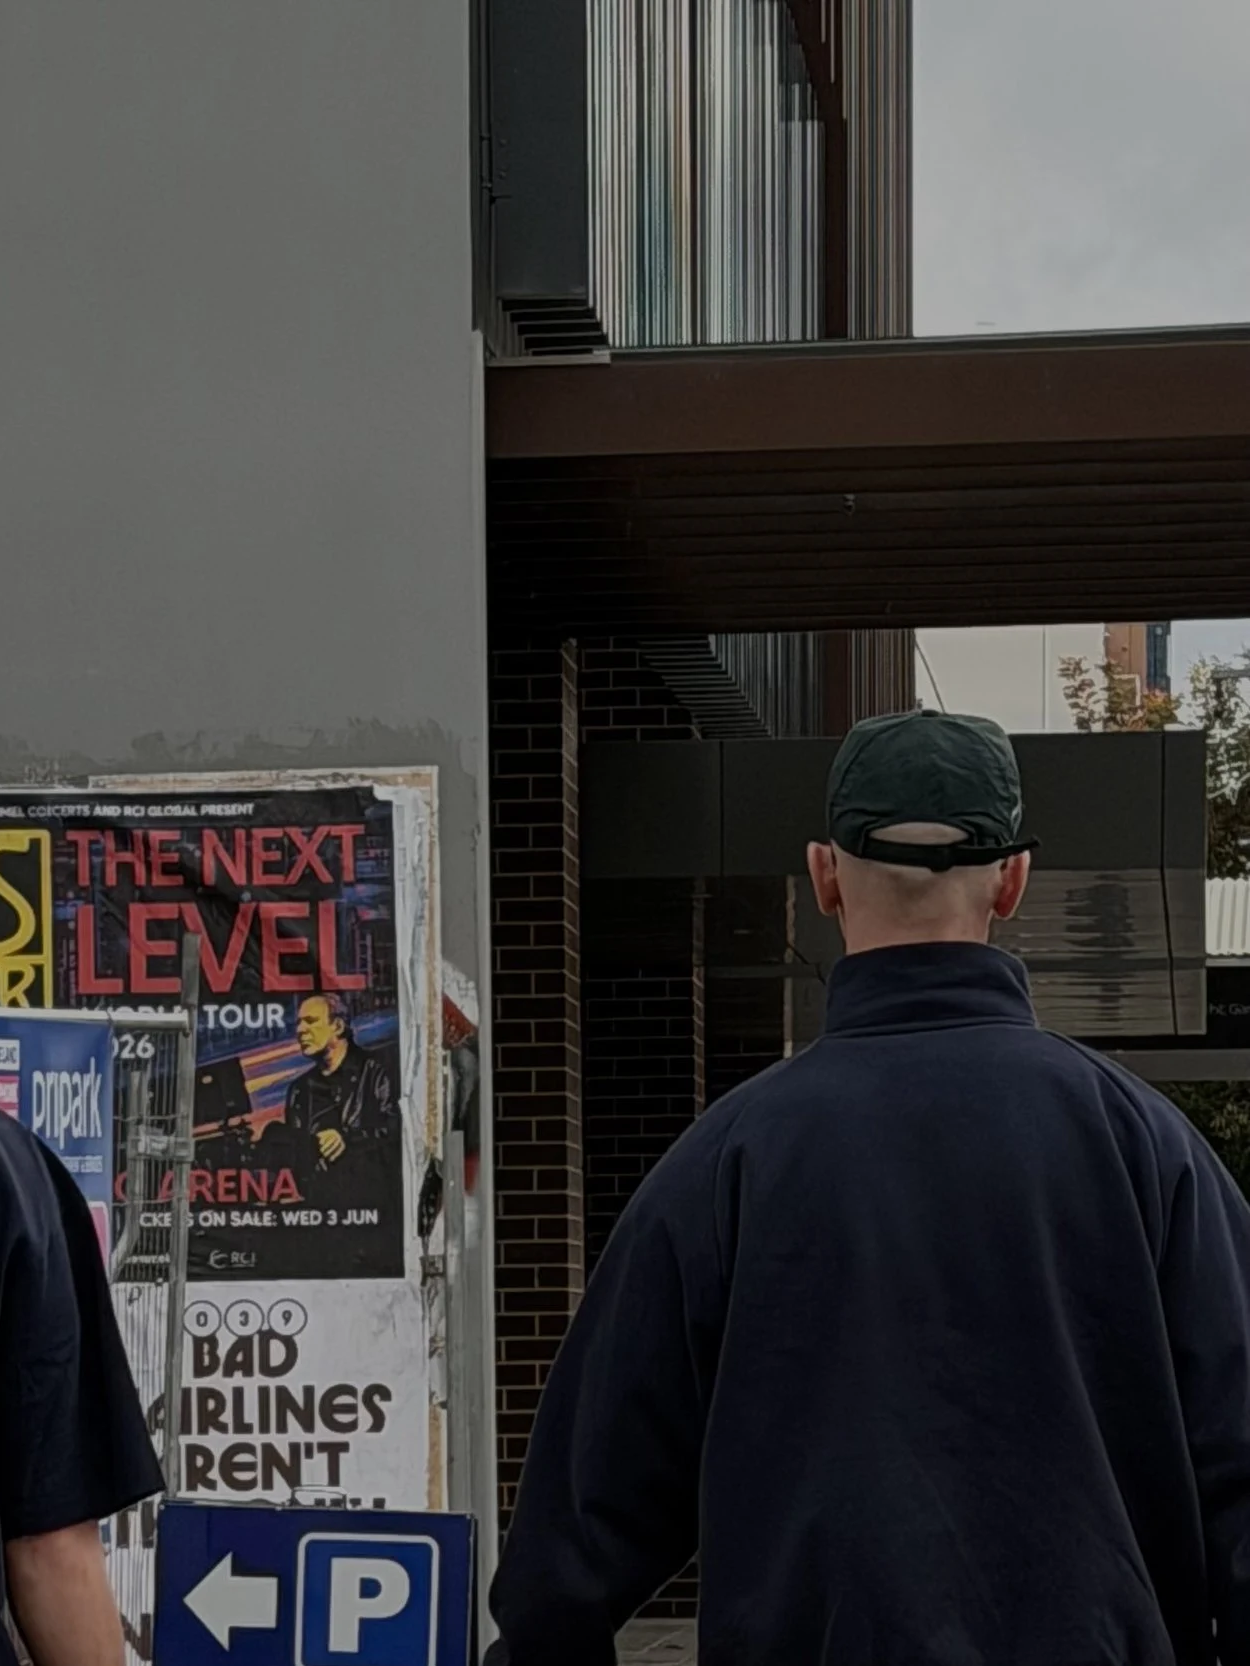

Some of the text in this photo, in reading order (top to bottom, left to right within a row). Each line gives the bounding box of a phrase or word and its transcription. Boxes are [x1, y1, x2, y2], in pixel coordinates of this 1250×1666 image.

[93, 804, 121, 816] AND
[147, 804, 199, 817] GLOBAL
[200, 803, 255, 817] PRESENT
[66, 825, 366, 888] THE NEXT
[76, 900, 368, 993] LEVEL
[203, 1003, 286, 1030] TOUR
[200, 1211, 225, 1227] ON
[230, 1210, 277, 1227] SALE:
[282, 1209, 322, 1226] WED
[327, 1209, 338, 1225] 3
[342, 1208, 379, 1226] JUN
[192, 1331, 299, 1379] BAD
[328, 1557, 410, 1653] P
